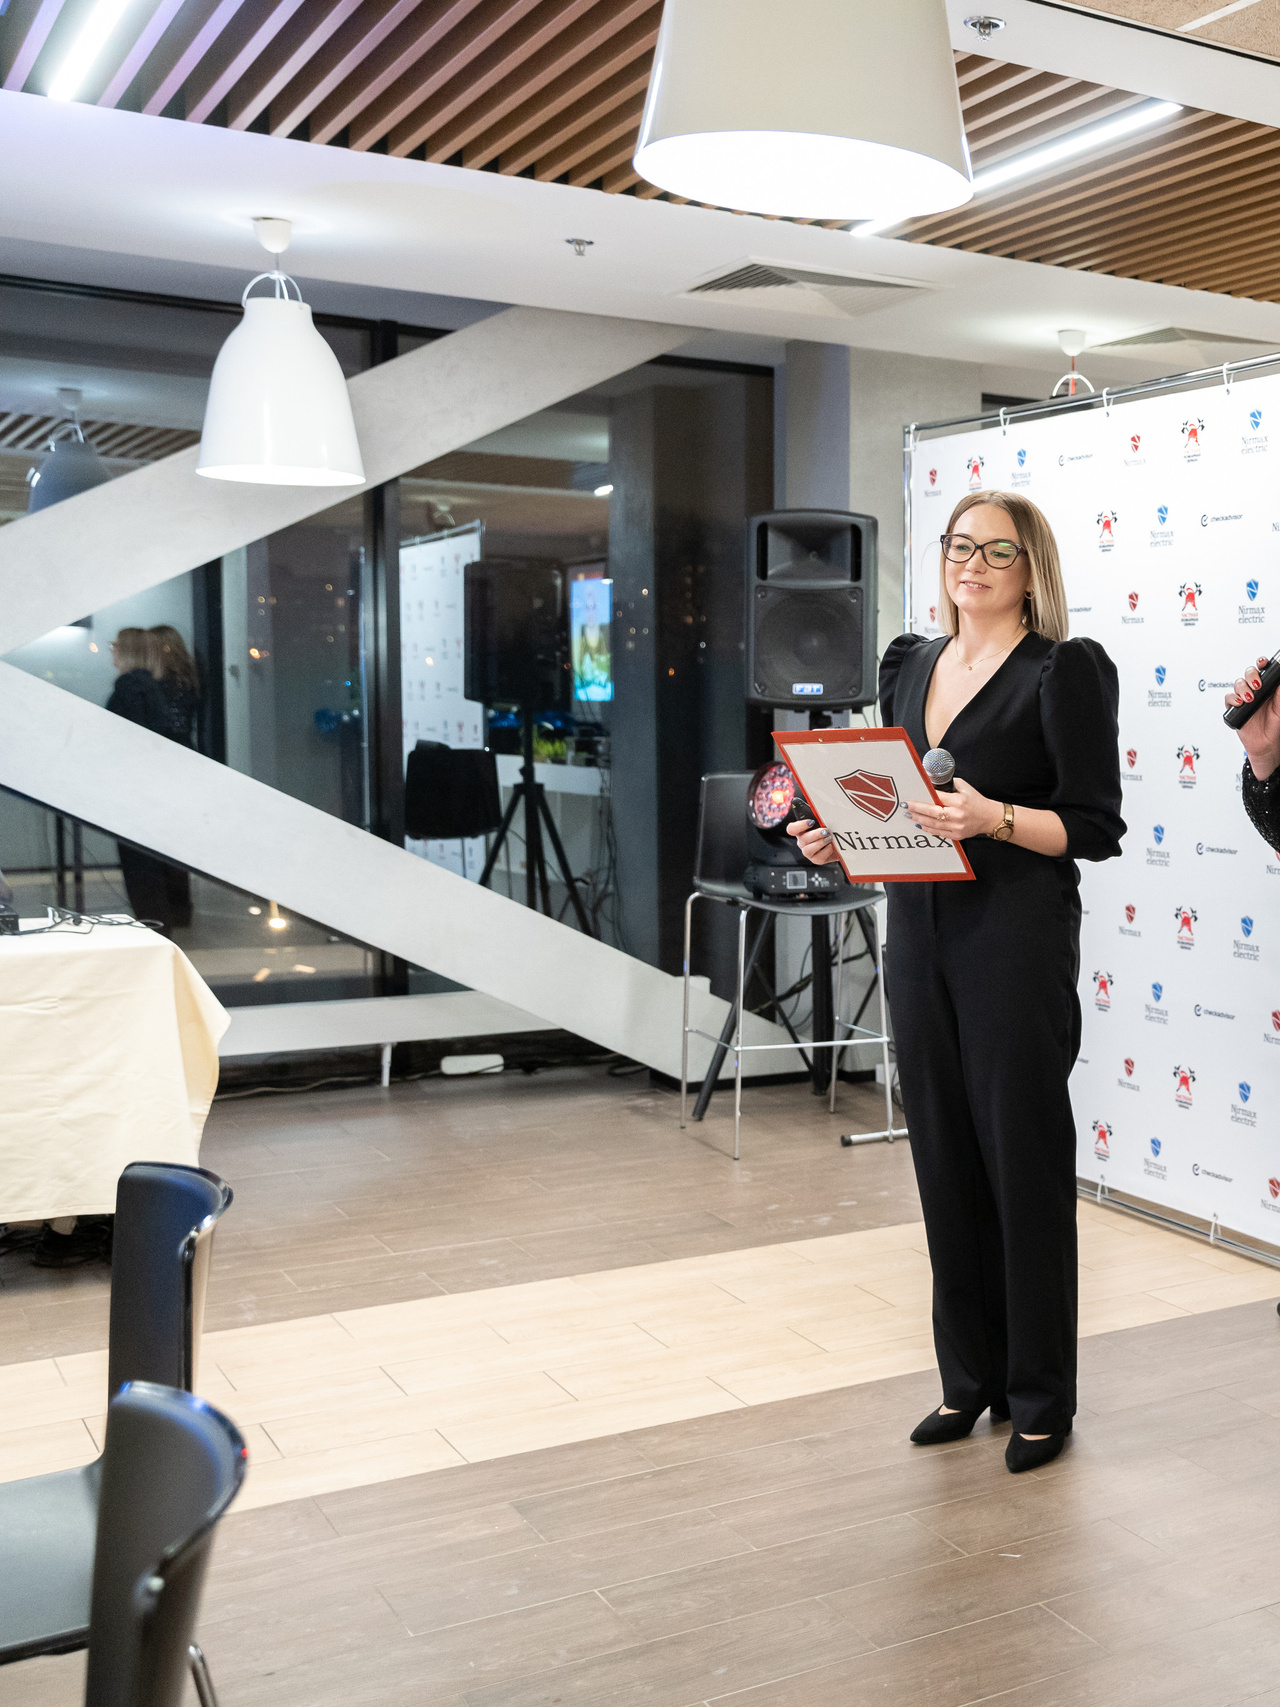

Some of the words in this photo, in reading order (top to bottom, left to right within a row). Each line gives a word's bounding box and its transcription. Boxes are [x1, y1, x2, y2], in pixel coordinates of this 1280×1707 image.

[1241, 435, 1269, 446] Nirmax
[1240, 444, 1269, 455] electric
[1210, 514, 1244, 523] checkadvisor
[1149, 530, 1175, 540] Nirmax
[1238, 605, 1266, 615] Nirmax
[1121, 615, 1145, 625] Nirmax
[1237, 614, 1266, 625] electric
[1147, 689, 1173, 700] Nirmax
[1147, 698, 1172, 708] electric
[832, 831, 954, 851] Nirmax
[1146, 847, 1171, 858] Nirmax
[1205, 846, 1239, 856] checkadvisor
[1146, 857, 1171, 868] electric
[1118, 925, 1142, 937] Nirmax
[1233, 940, 1261, 953] Nirmax
[1233, 950, 1261, 962] electric
[1144, 1004, 1169, 1017] Nirmax
[1203, 1009, 1236, 1021] checkadvisor
[1144, 1014, 1169, 1026] electric
[1117, 1078, 1141, 1092] Nirmax
[1230, 1104, 1258, 1119] Nirmax
[1230, 1114, 1258, 1128] electric
[1143, 1157, 1168, 1172] Nirmax
